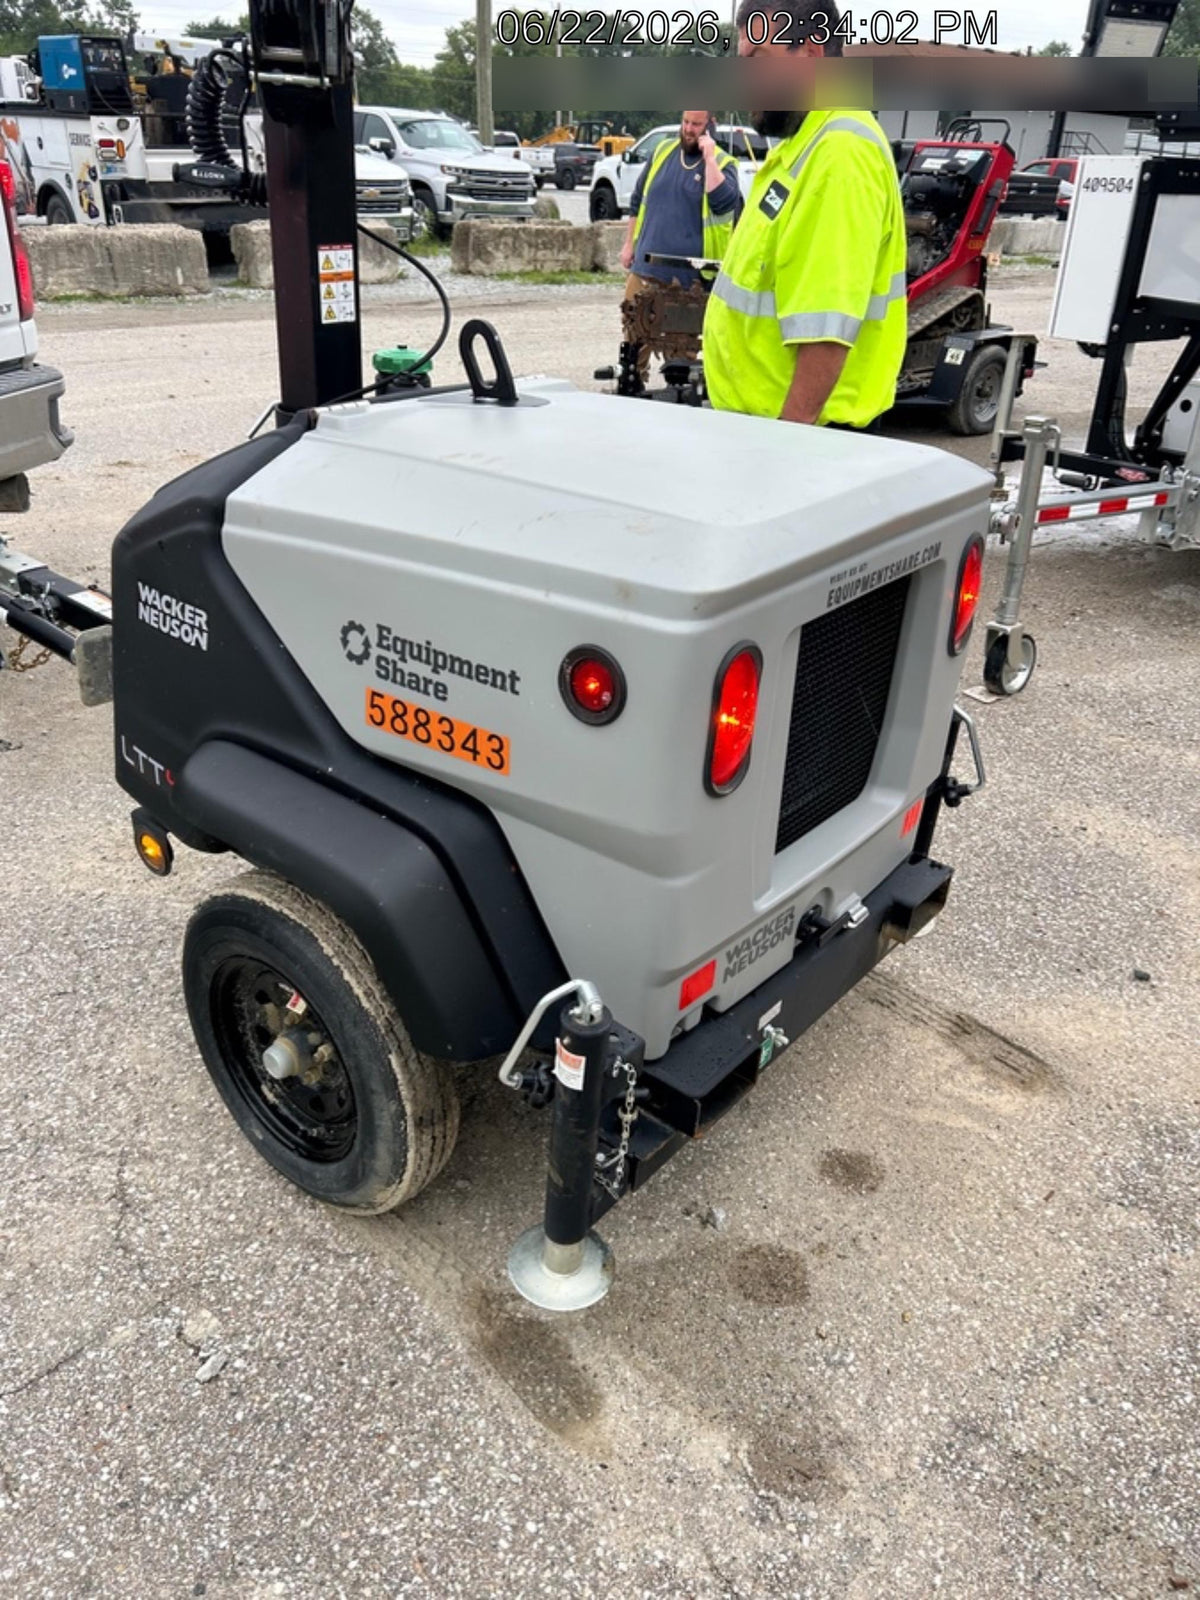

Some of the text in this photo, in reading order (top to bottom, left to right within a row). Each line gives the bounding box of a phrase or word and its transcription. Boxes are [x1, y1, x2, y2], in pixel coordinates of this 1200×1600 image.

[68, 132, 92, 147] SERVICE
[1082, 176, 1134, 193] 409504
[826, 541, 942, 609] EQUIPMENTSHARE.COM
[138, 581, 208, 631] WACKER
[138, 601, 208, 651] NEUSON
[375, 654, 449, 701] Share
[376, 623, 521, 696] Equipment
[368, 691, 505, 771] 588343
[723, 920, 795, 984] NEUSON
[726, 906, 796, 964] WACKER
